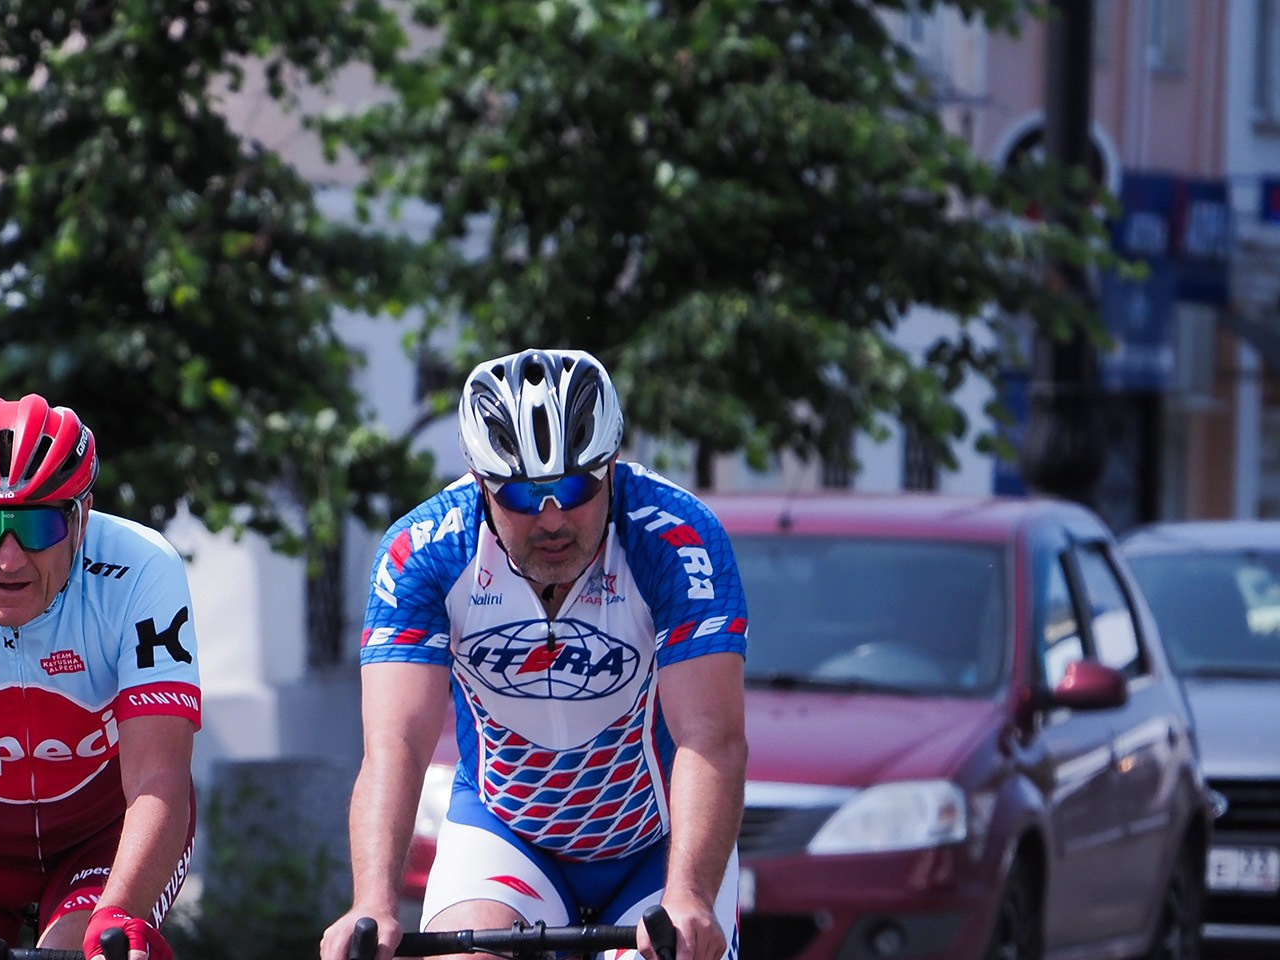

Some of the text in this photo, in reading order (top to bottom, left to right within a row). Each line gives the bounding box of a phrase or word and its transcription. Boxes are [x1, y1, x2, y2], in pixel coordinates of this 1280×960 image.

[627, 505, 714, 600] ITERA
[469, 593, 503, 606] Nalini
[42, 658, 79, 668] KATUSHA
[51, 652, 72, 661] TEAM
[468, 643, 624, 677] ITERA
[49, 664, 83, 674] ALPECIN
[128, 691, 199, 712] CANYON
[151, 837, 195, 930] KATUSH
